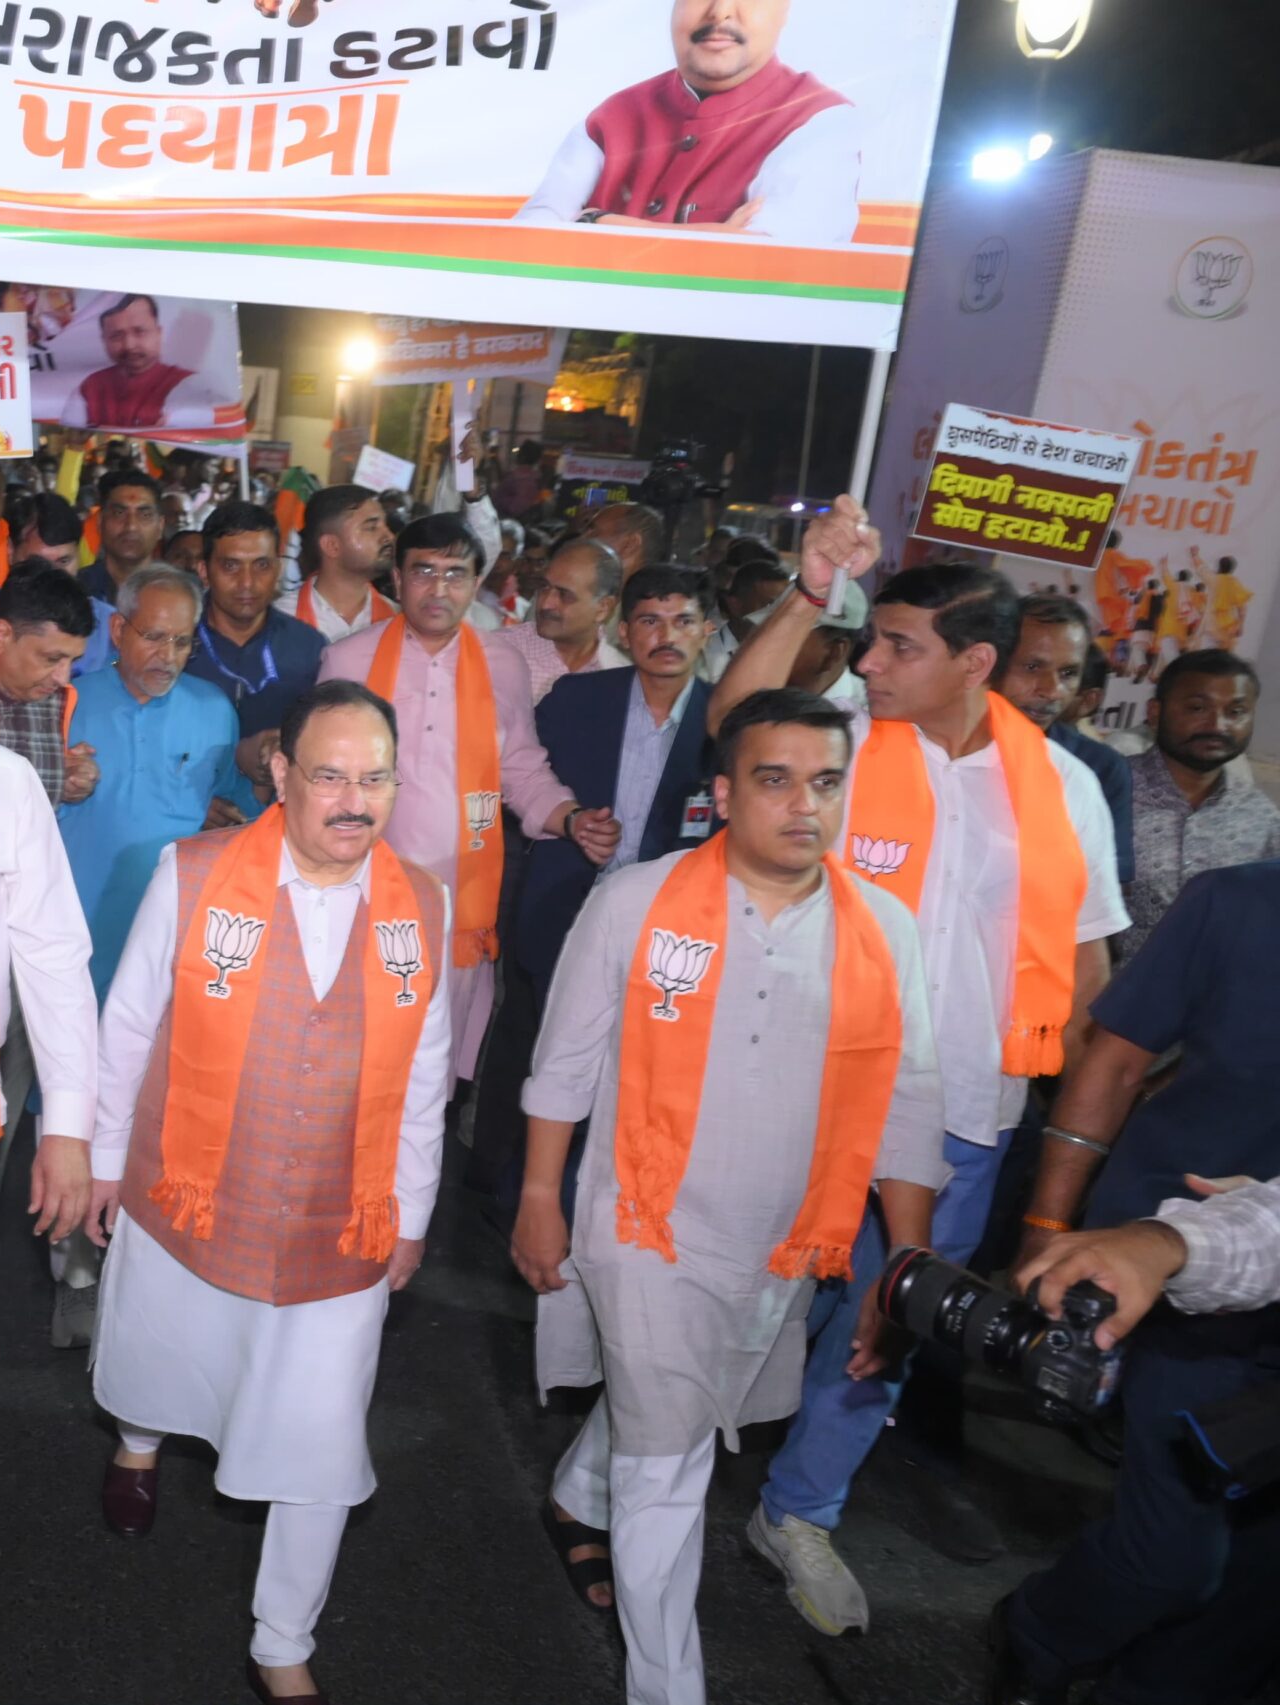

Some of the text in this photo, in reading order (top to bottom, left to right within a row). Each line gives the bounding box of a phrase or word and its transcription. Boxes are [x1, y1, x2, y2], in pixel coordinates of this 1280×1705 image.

[329, 0, 557, 79] હટાવો
[18, 92, 401, 177] પદયાત્રા
[1022, 435, 1036, 456] से
[1041, 438, 1069, 461] देश
[1073, 449, 1128, 473] बचाओ
[1131, 419, 1259, 486] ોકતંત્ર
[929, 463, 1016, 505] दिमागी
[1015, 485, 1116, 523] नक्सली
[932, 498, 985, 532] सोच
